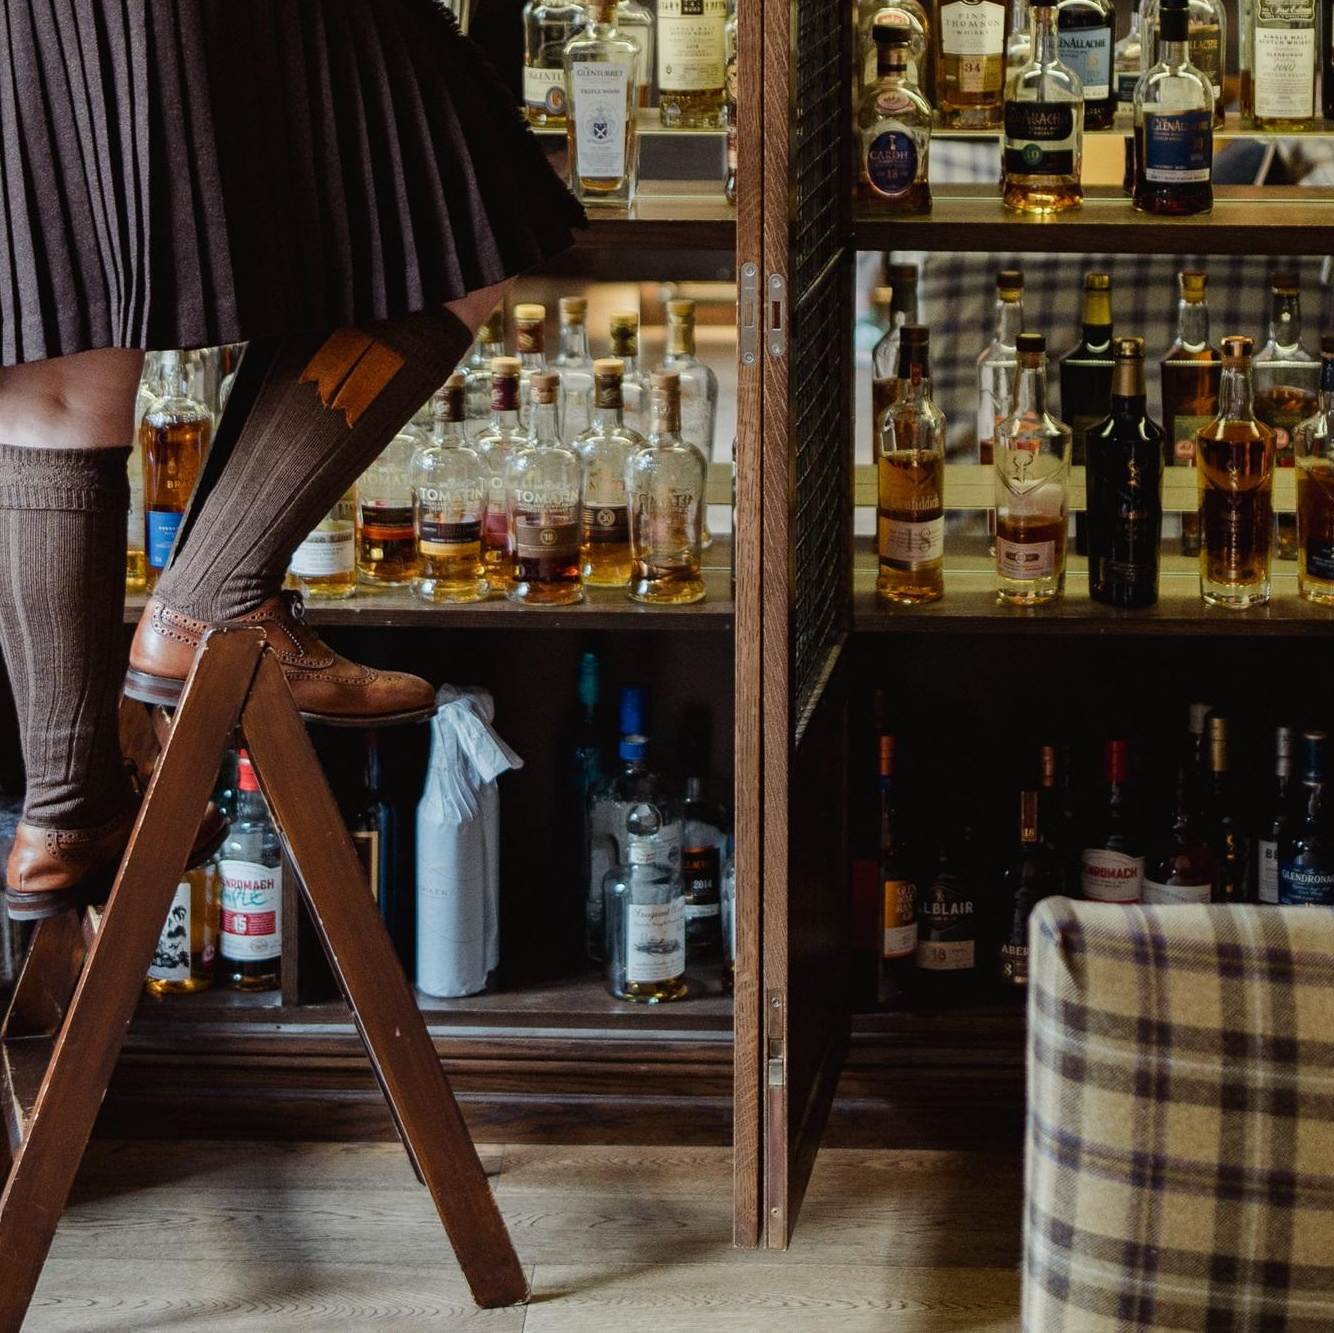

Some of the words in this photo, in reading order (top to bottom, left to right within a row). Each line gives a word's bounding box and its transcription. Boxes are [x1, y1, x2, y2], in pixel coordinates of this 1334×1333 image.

[945, 19, 1002, 29] THOMSON
[576, 69, 624, 78] GLENTURRET
[869, 150, 908, 160] CARDH
[923, 901, 974, 916] LBLAIR
[232, 914, 247, 933] 15
[1001, 944, 1029, 956] ABER
